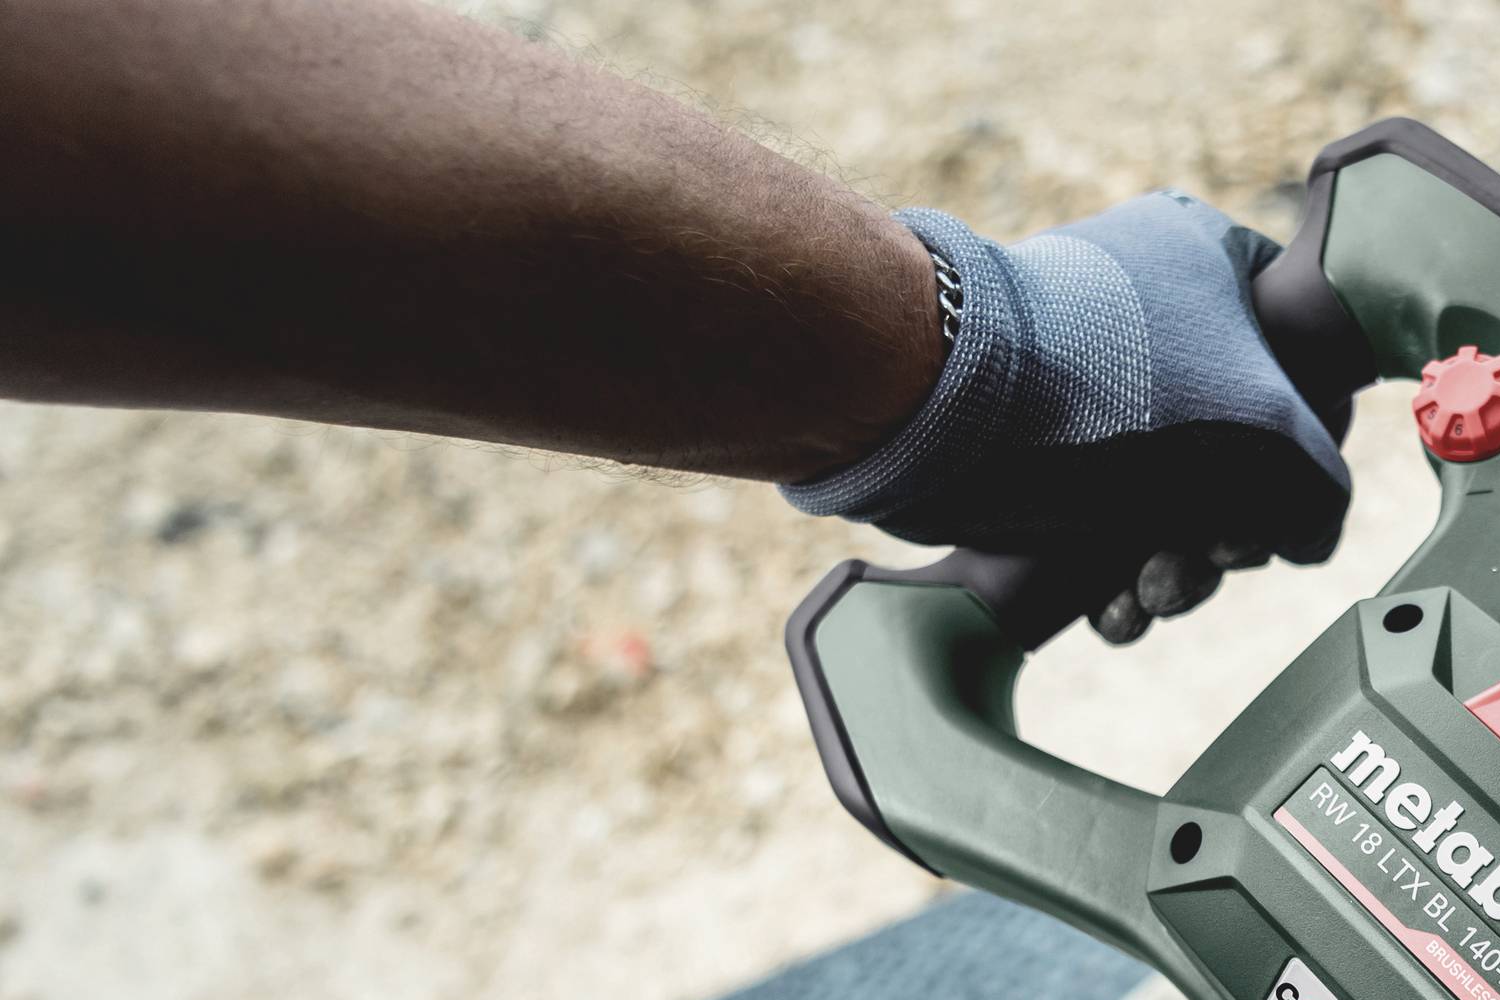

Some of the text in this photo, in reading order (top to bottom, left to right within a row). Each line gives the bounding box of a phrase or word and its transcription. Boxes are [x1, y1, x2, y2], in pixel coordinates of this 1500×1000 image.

[1454, 423, 1464, 436] 6
[1308, 781, 1356, 826] RW
[1351, 821, 1383, 856] 18
[1377, 848, 1431, 901] LTX
[1422, 892, 1455, 933] BL
